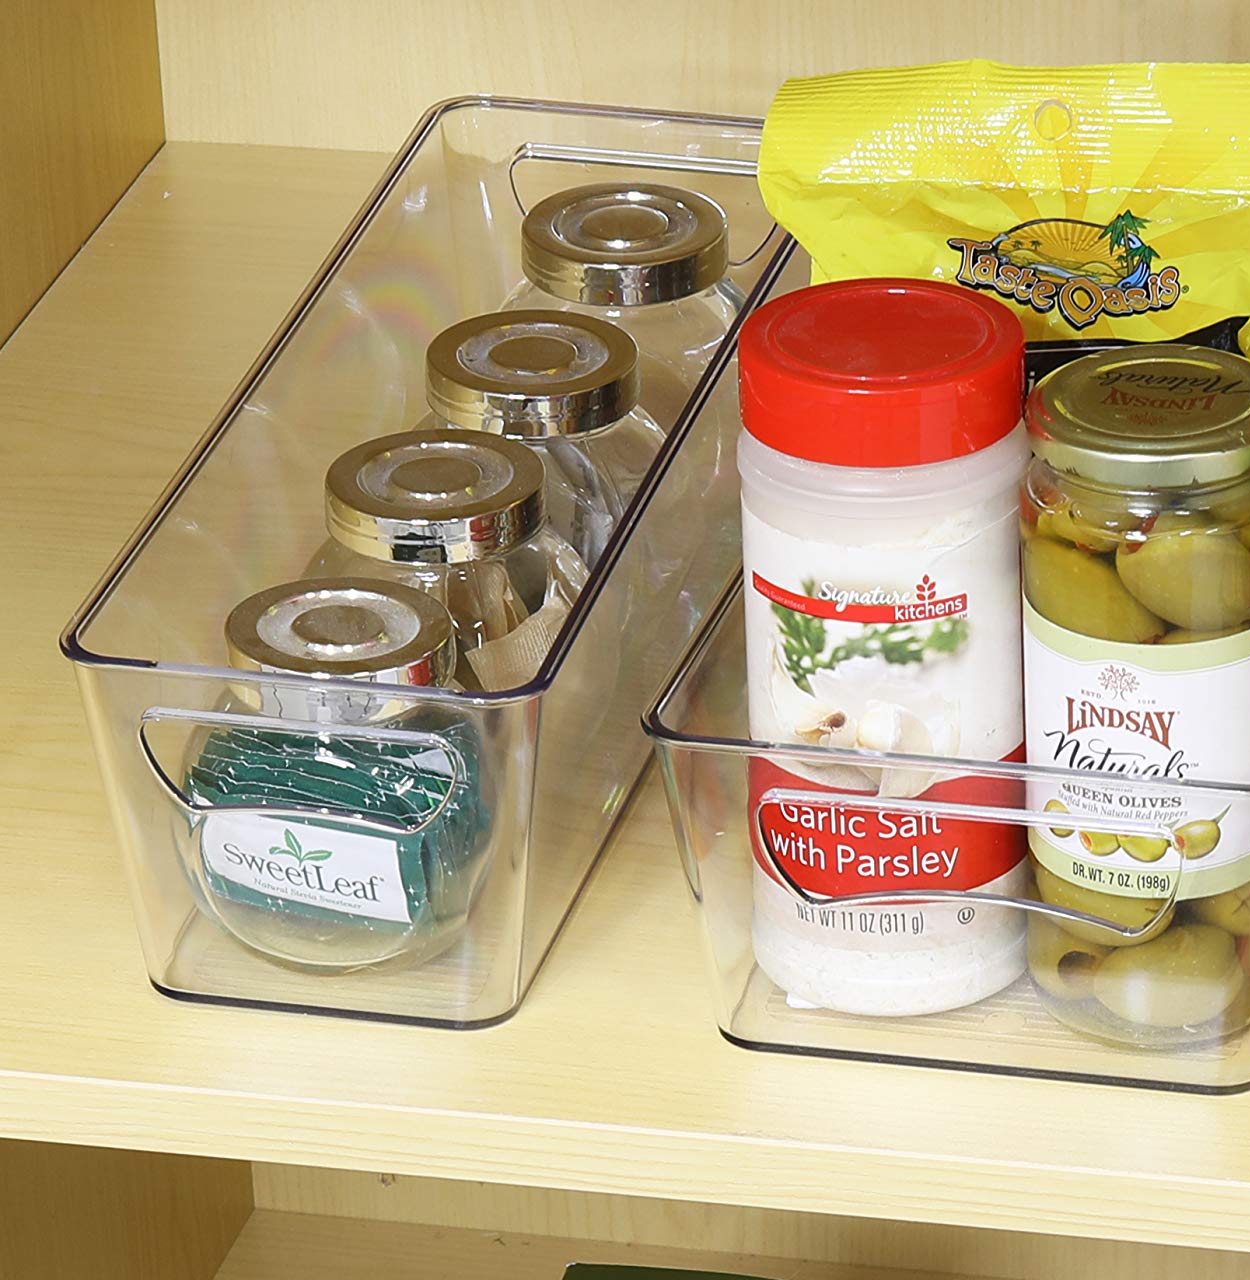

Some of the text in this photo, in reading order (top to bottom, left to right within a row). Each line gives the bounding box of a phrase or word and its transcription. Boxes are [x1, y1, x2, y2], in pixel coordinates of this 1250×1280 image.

[948, 239, 1181, 330] Taste Oasis
[1102, 387, 1218, 413] LINDSAY
[817, 581, 914, 613] Signature
[894, 598, 964, 621] kitchens
[1065, 695, 1176, 751] LINDSAY
[1062, 782, 1183, 809] QUEEN OLIVES
[779, 802, 942, 839] Garlic Salt
[1100, 803, 1189, 823] Natural Red Peppers
[770, 829, 959, 878] with Parsley
[222, 842, 382, 903] SweetLeaf
[1108, 868, 1171, 892] 7 OZ. (198g)
[796, 903, 816, 923] NET
[818, 909, 838, 929] WT
[840, 912, 854, 931] 11
[859, 913, 876, 934] OZ
